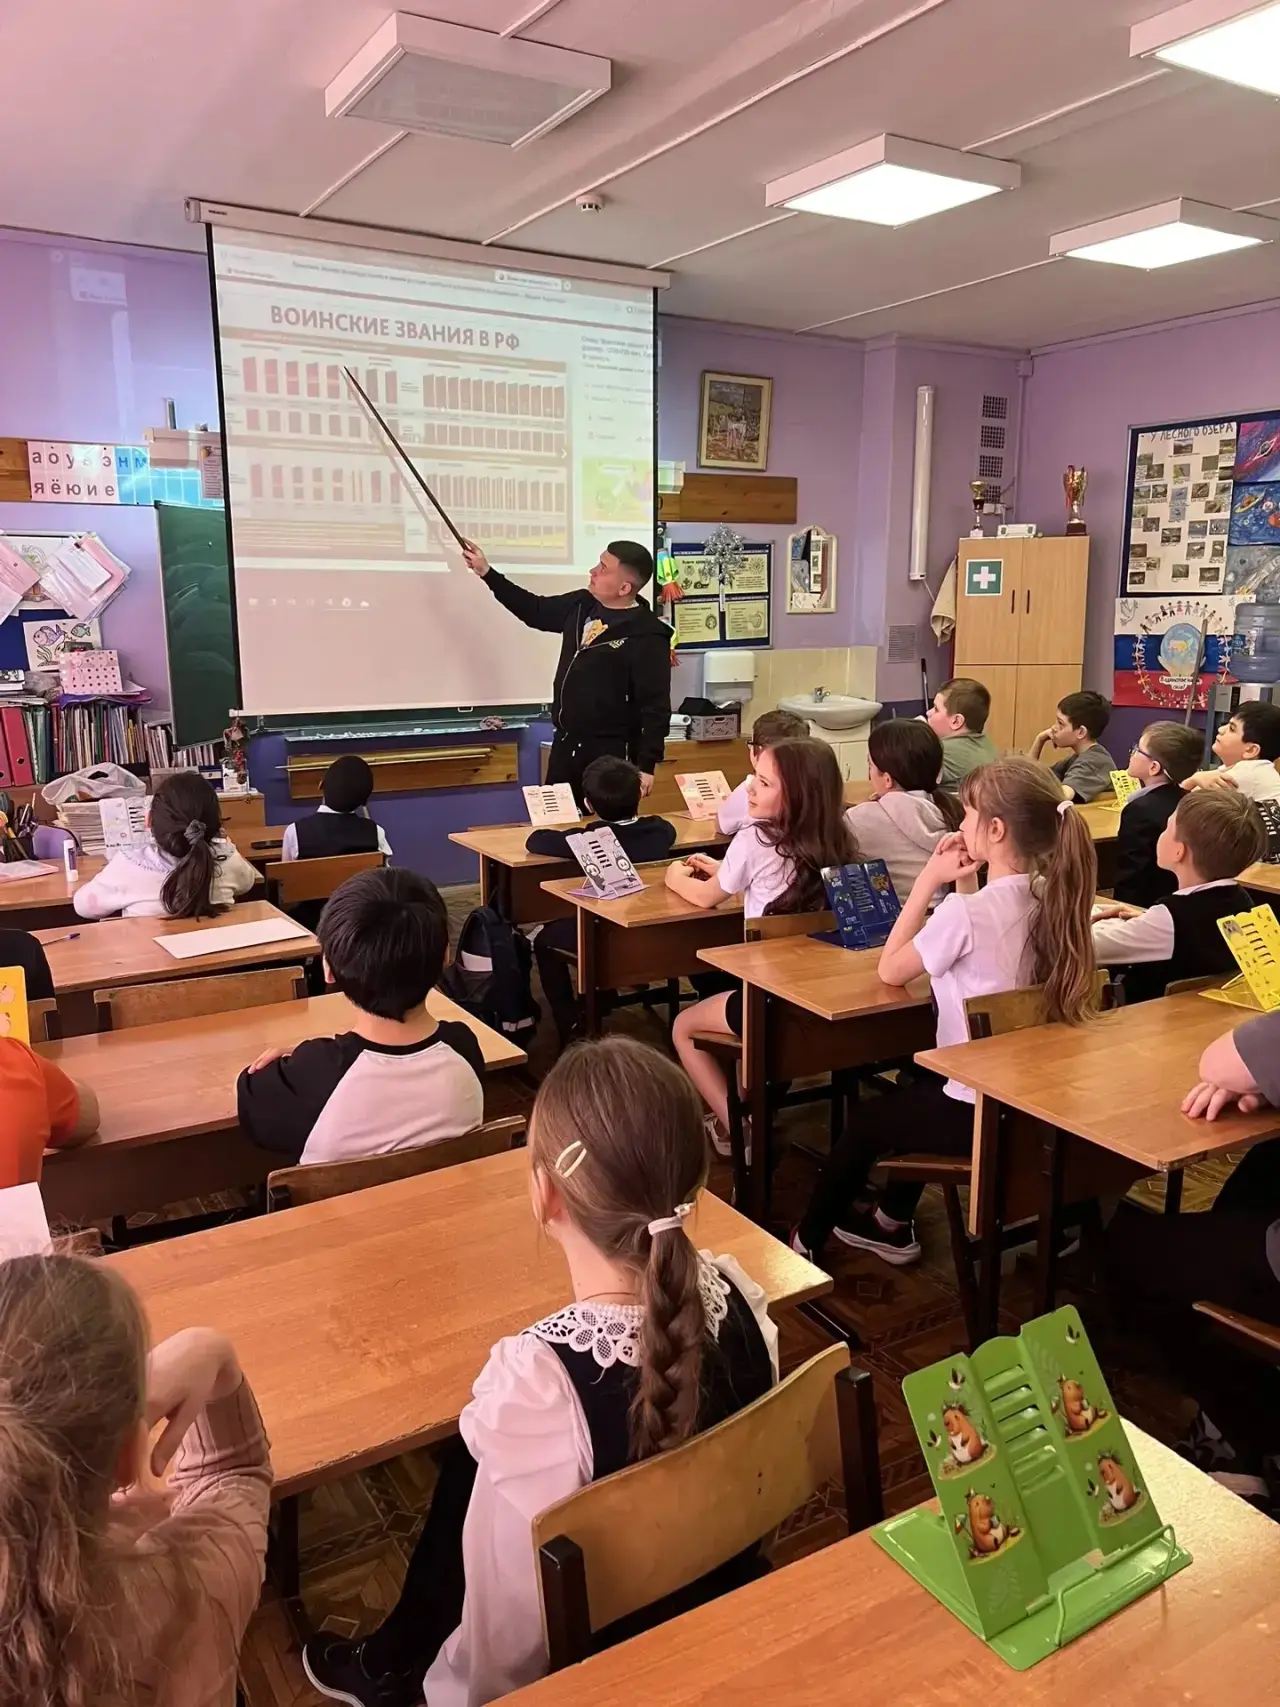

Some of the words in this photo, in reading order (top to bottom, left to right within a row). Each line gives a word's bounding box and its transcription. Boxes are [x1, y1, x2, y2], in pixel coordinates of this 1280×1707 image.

[271, 305, 390, 336] ВОИНСКИЕ
[394, 320, 474, 346] ЗВАНИЯ
[479, 330, 490, 347] В
[494, 331, 520, 351] РФ
[1160, 427, 1200, 440] ЛЕСНОГО
[1202, 423, 1233, 437] ОЗЕРА
[32, 451, 42, 464] а
[102, 456, 112, 467] э
[34, 482, 45, 494] я
[51, 479, 61, 495] ё
[66, 484, 82, 496] ю
[87, 485, 98, 496] и
[104, 485, 115, 496] е
